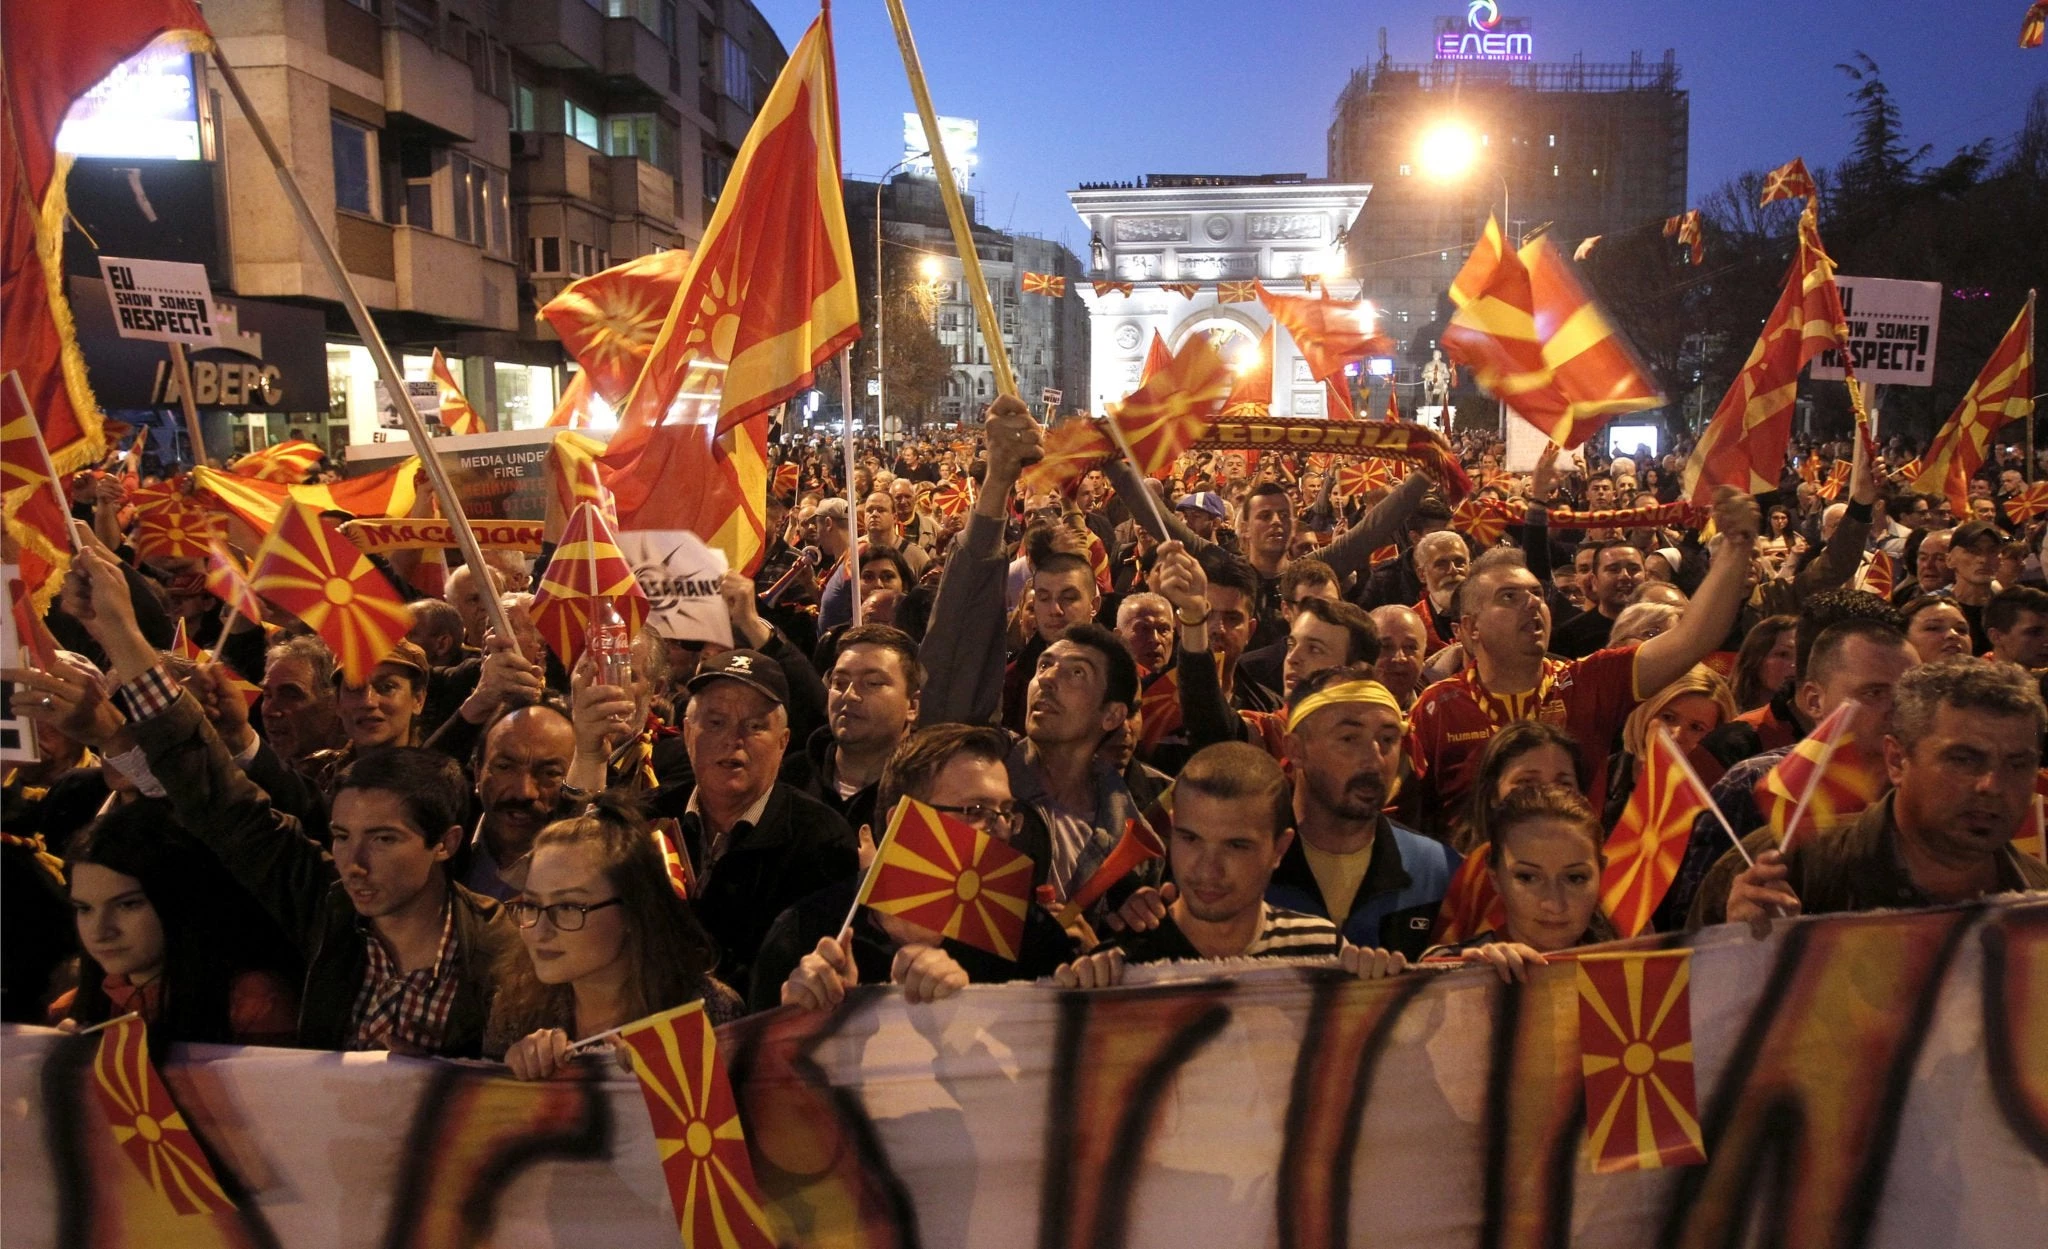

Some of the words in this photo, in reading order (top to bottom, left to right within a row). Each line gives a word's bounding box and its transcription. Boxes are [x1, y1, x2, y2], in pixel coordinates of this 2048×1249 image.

[115, 292, 153, 308] SHOW
[159, 295, 198, 311] SOME
[119, 298, 213, 336] RESPECT!
[1847, 321, 1868, 338] OW
[1875, 322, 1918, 340] SOME
[373, 432, 387, 443] EU
[460, 454, 504, 469] MEDIA
[507, 450, 549, 464] UNDE
[493, 465, 525, 478] FIRE
[360, 523, 544, 547] MACDON
[1447, 729, 1490, 743] hummel
